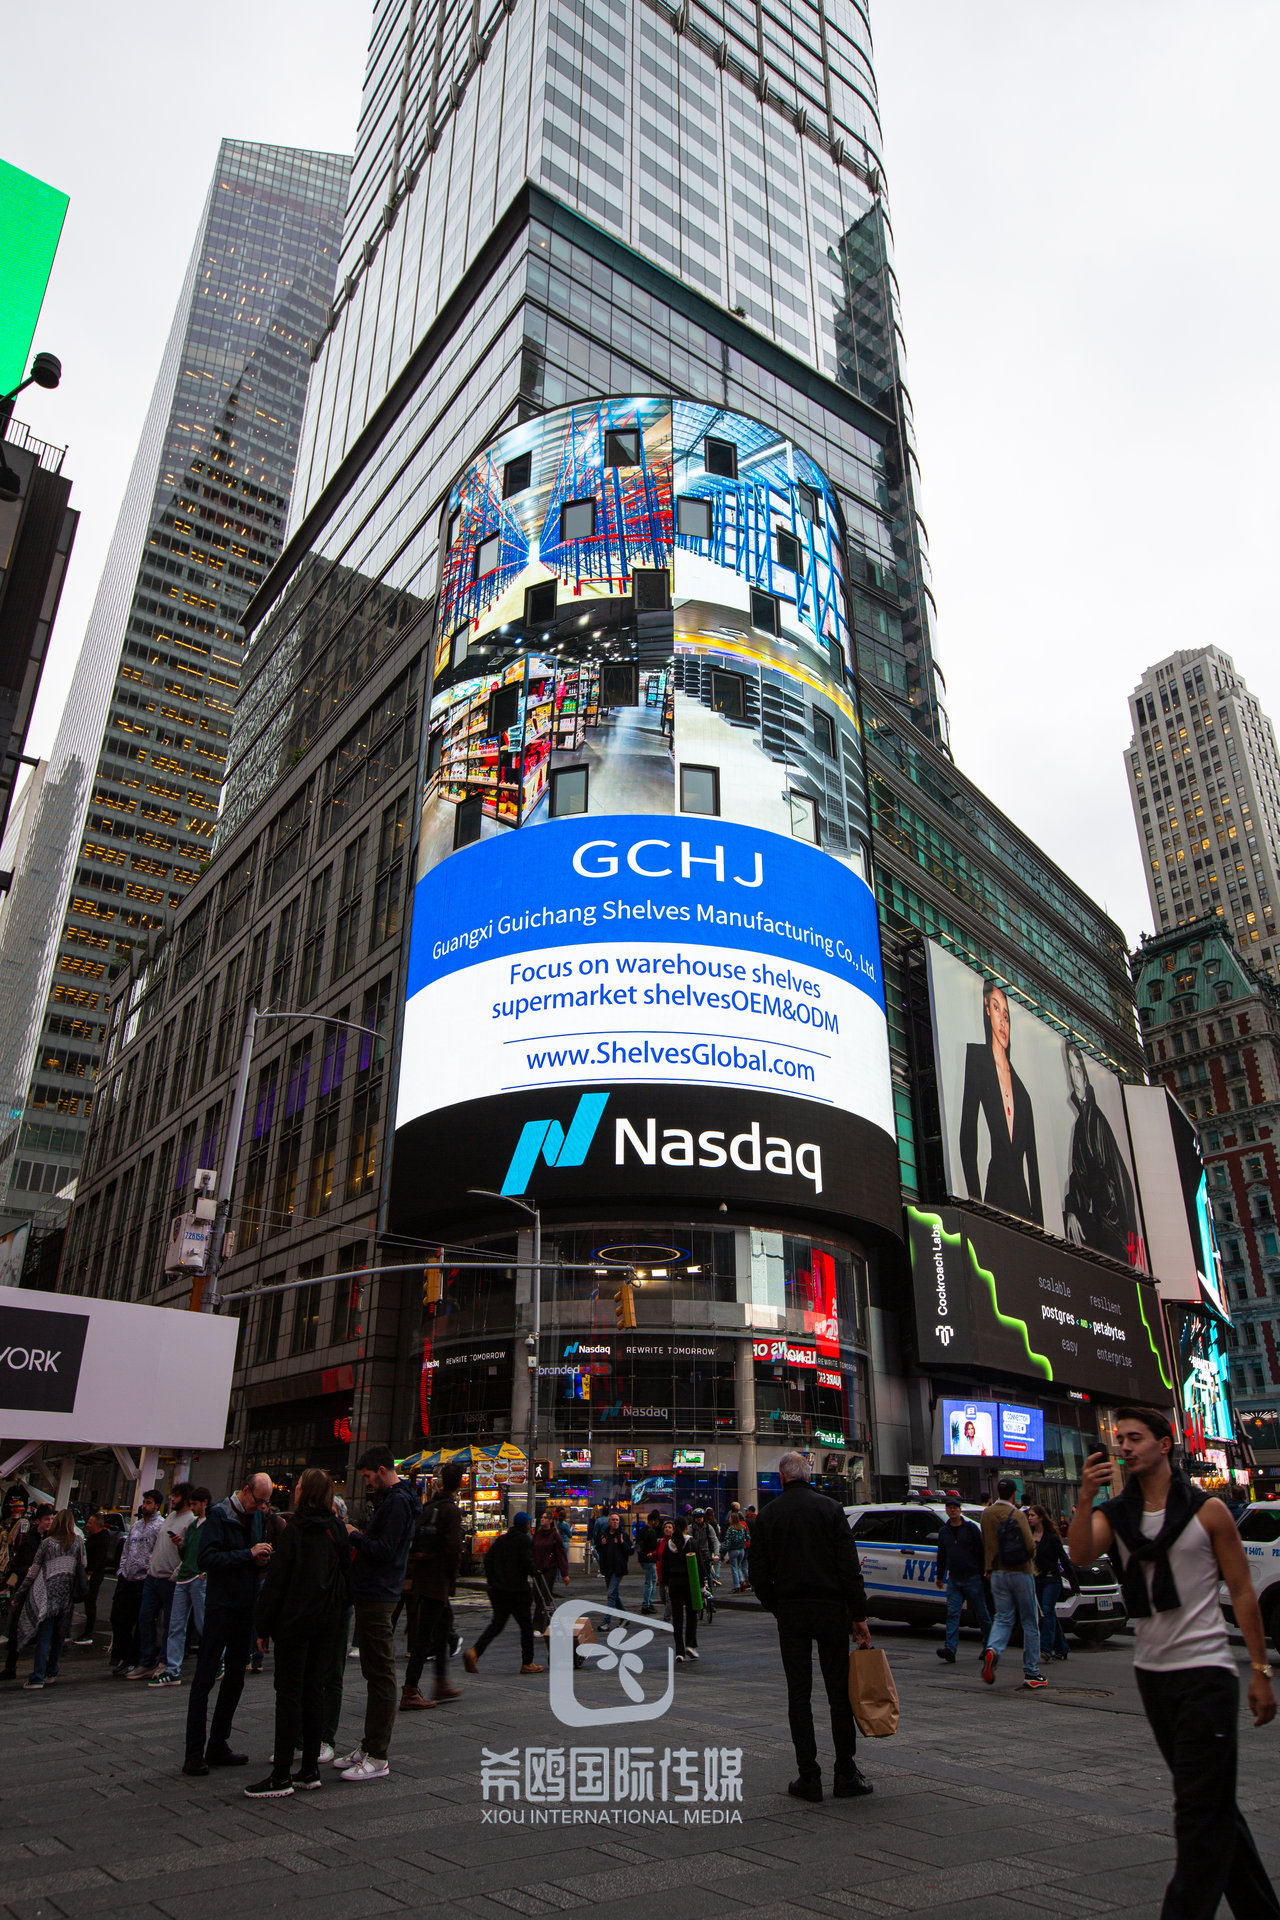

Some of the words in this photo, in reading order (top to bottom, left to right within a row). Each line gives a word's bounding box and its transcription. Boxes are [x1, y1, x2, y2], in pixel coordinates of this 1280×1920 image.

[572, 839, 764, 887] GCHJ
[432, 919, 493, 959] Guangxi
[497, 906, 597, 934] Guichang
[602, 899, 691, 921] Shelves
[696, 904, 834, 958] Manufacturing
[509, 957, 573, 985] Focus
[578, 958, 609, 976] on
[616, 953, 747, 982] warehouse
[752, 963, 822, 998] shelves
[492, 983, 638, 1020] supermarket
[643, 982, 840, 1035] shelvesOEM&ODM
[526, 1041, 817, 1082] www.ShelvesGlobal.com
[615, 1117, 824, 1195] Nasdaq
[931, 1223, 942, 1252] Labs
[933, 1252, 949, 1316] Cockroach
[1038, 1276, 1072, 1298] scalable
[1041, 1304, 1075, 1326] postgres
[1092, 1321, 1126, 1342] petabytes
[1089, 1295, 1122, 1316] resilient
[578, 1344, 611, 1356] Nasdaq
[626, 1346, 664, 1355] REWRITE
[667, 1346, 715, 1356] TOMORROW
[1061, 1338, 1078, 1357] easy
[1096, 1348, 1133, 1368] enterprise
[622, 1405, 669, 1420] Nasdaq
